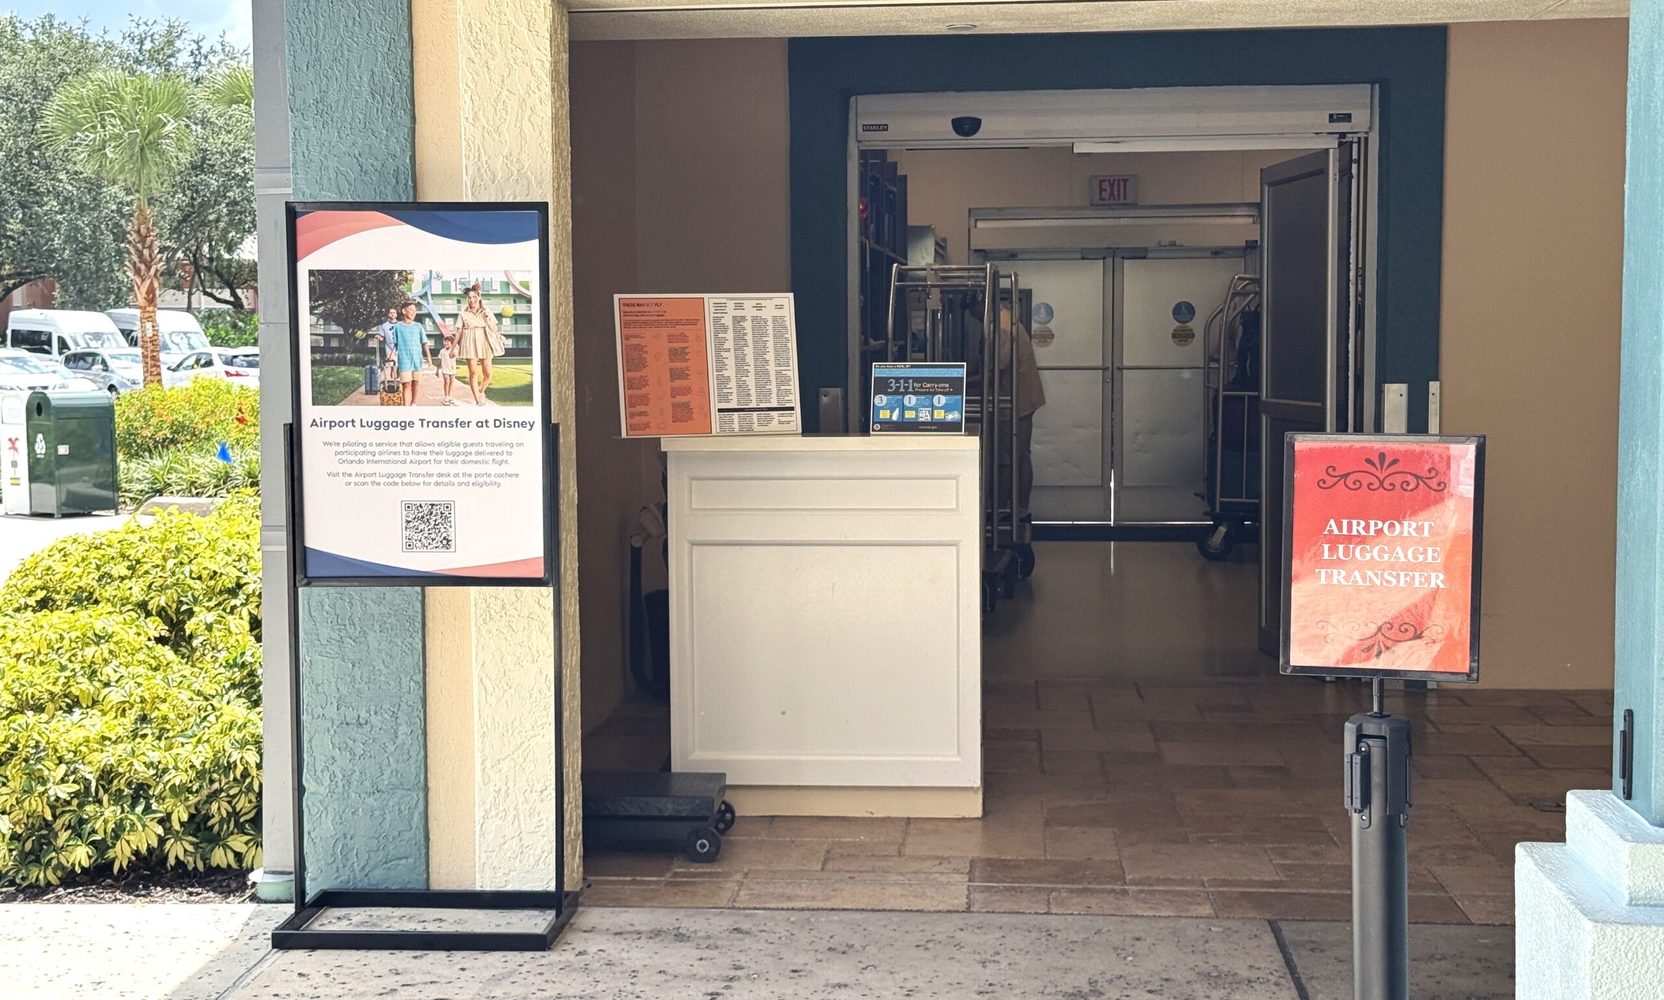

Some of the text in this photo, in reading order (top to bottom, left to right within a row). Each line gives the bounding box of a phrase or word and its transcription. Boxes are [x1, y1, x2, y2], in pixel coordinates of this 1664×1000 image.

[1098, 178, 1129, 202] EXIT
[888, 379, 914, 392] 3-1-1
[310, 418, 535, 431] Airport Luggage Transfer at Disney
[1322, 518, 1435, 537] AIRPORT
[1322, 543, 1441, 564] LUGGAGE
[1315, 568, 1447, 589] TRANSFER
